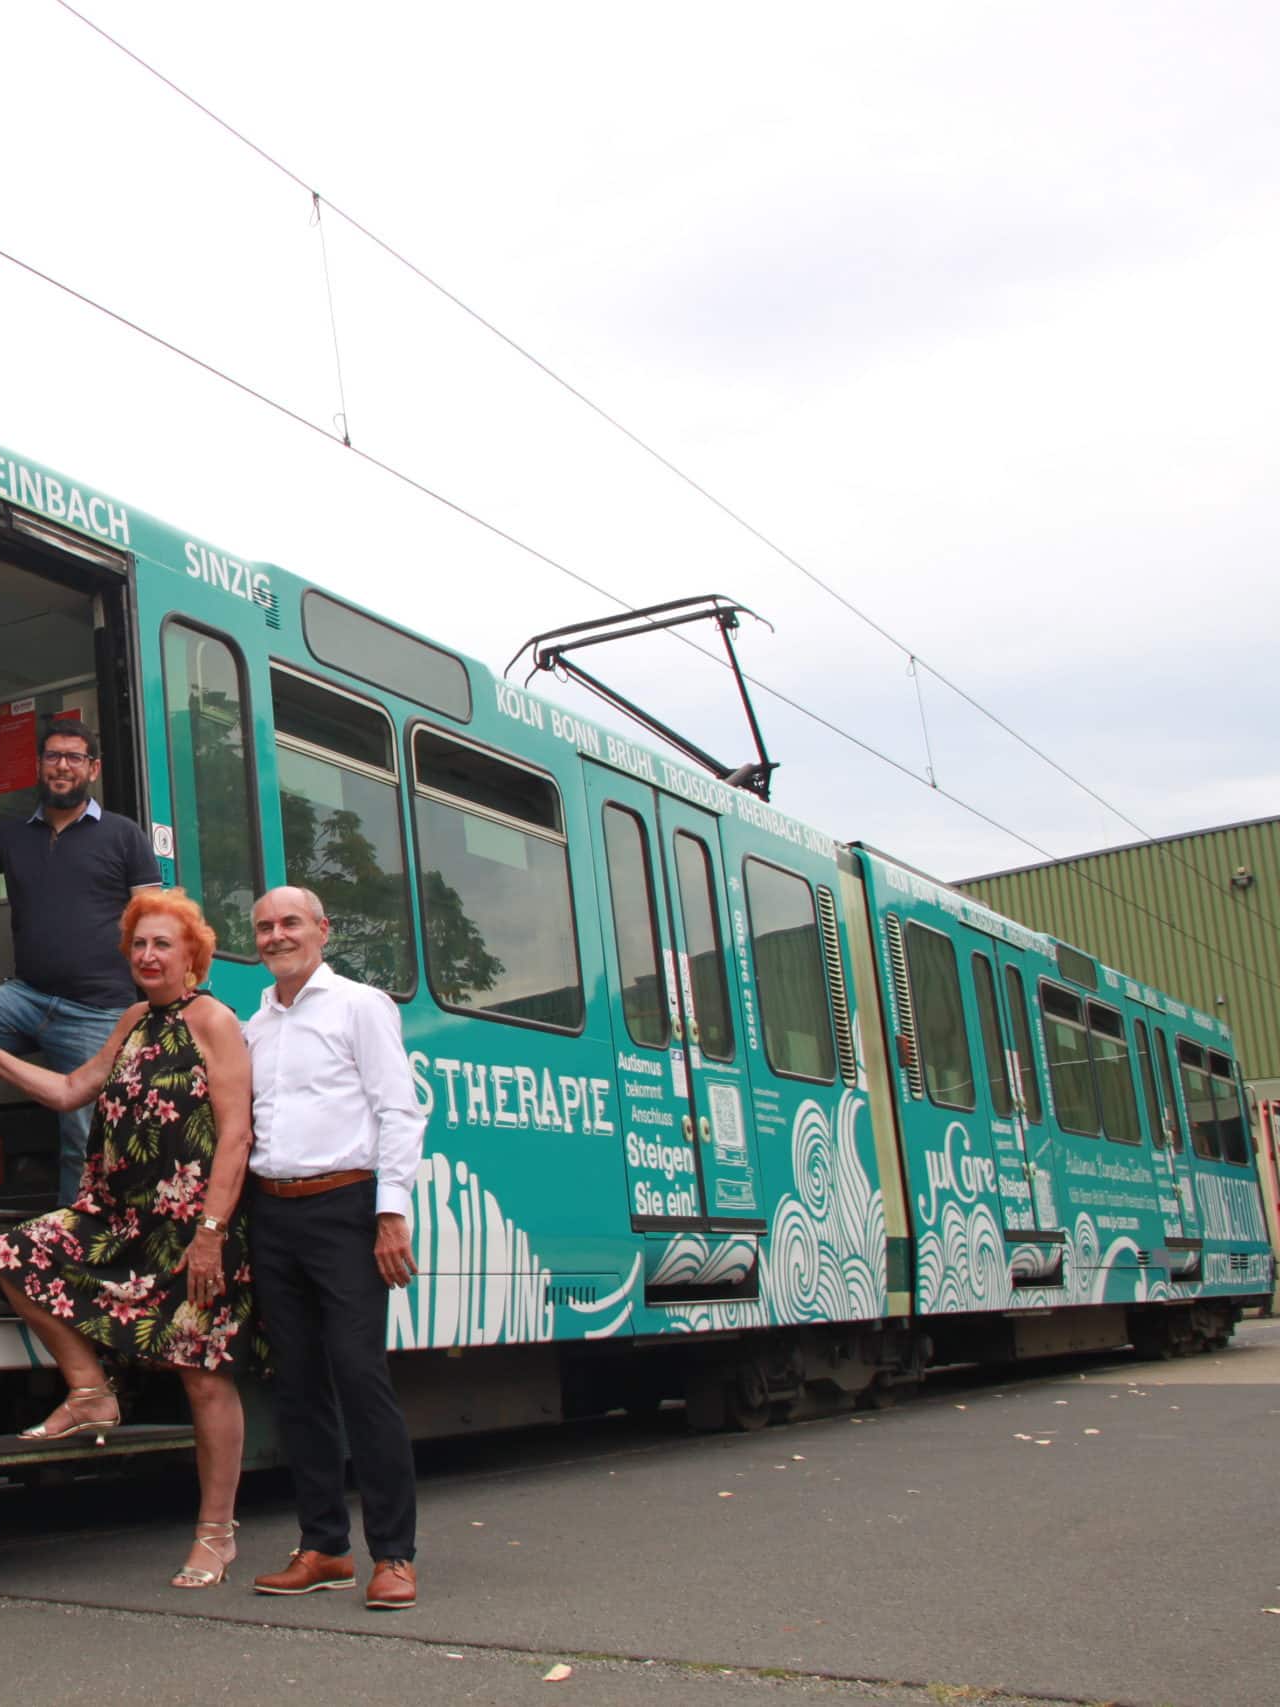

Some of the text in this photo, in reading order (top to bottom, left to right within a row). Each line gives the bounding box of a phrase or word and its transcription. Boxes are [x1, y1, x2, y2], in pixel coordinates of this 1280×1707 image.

[184, 541, 273, 608] SINZIG
[550, 709, 601, 756] BONN
[618, 1051, 663, 1077] Autismus
[625, 1080, 663, 1099] bekommt
[631, 1104, 673, 1127] Anschluss
[626, 1131, 696, 1180] Steigen
[634, 1181, 664, 1215] Sie
